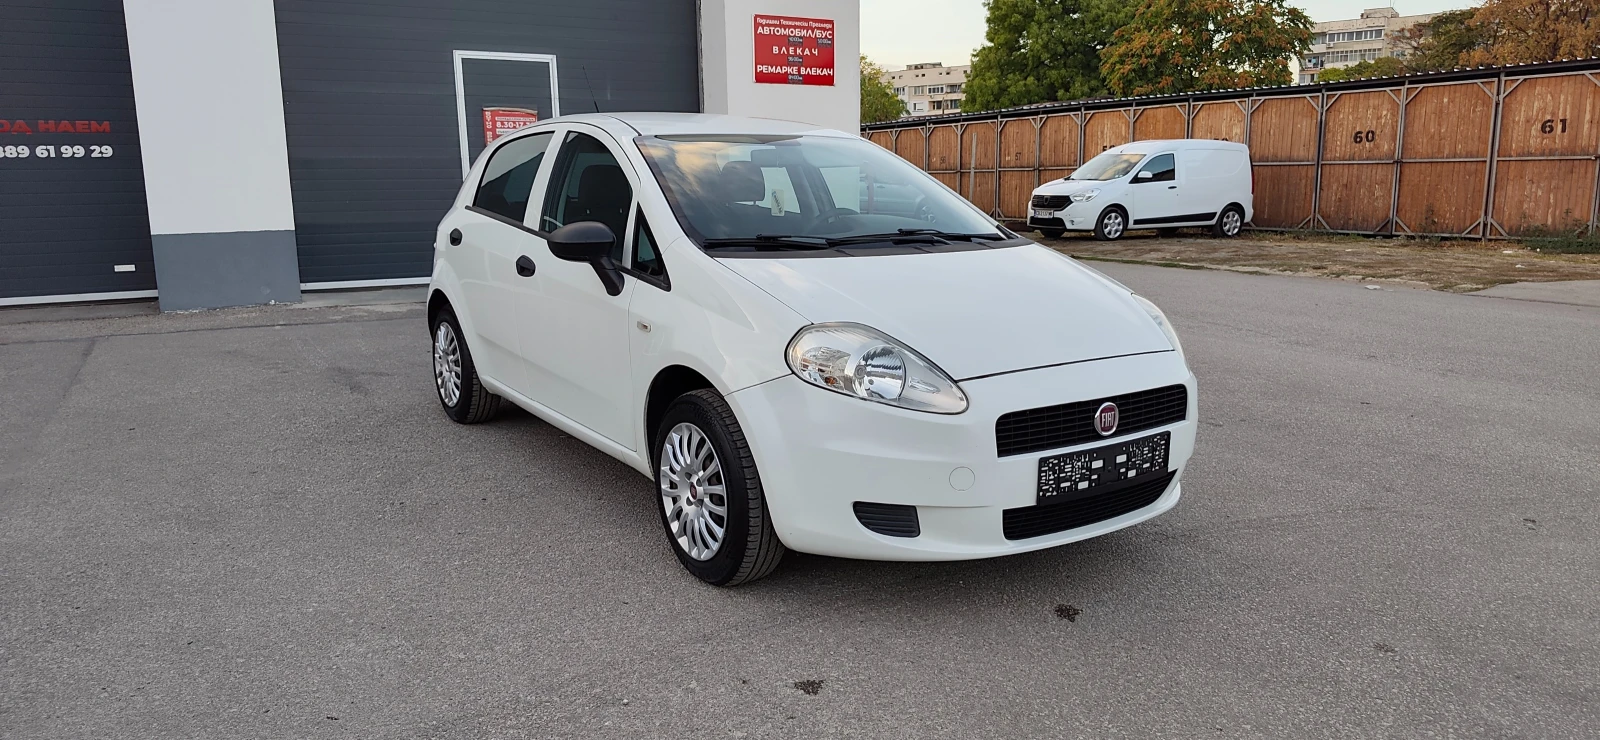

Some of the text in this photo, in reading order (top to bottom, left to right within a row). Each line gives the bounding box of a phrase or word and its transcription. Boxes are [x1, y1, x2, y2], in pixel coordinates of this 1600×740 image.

[757, 26, 833, 39] АВТОМОБИЛ/БУС
[772, 46, 818, 56] ВЛЕКАЧ
[757, 65, 833, 76] РЕМАРКЕ ВЛЕКАЧ
[38, 120, 111, 133] НАЕМ
[1540, 118, 1568, 134] 61
[1353, 129, 1376, 144] 60
[35, 145, 56, 158] 61
[60, 145, 86, 158] 99
[89, 145, 114, 158] 29
[1101, 411, 1115, 428] FIAT
